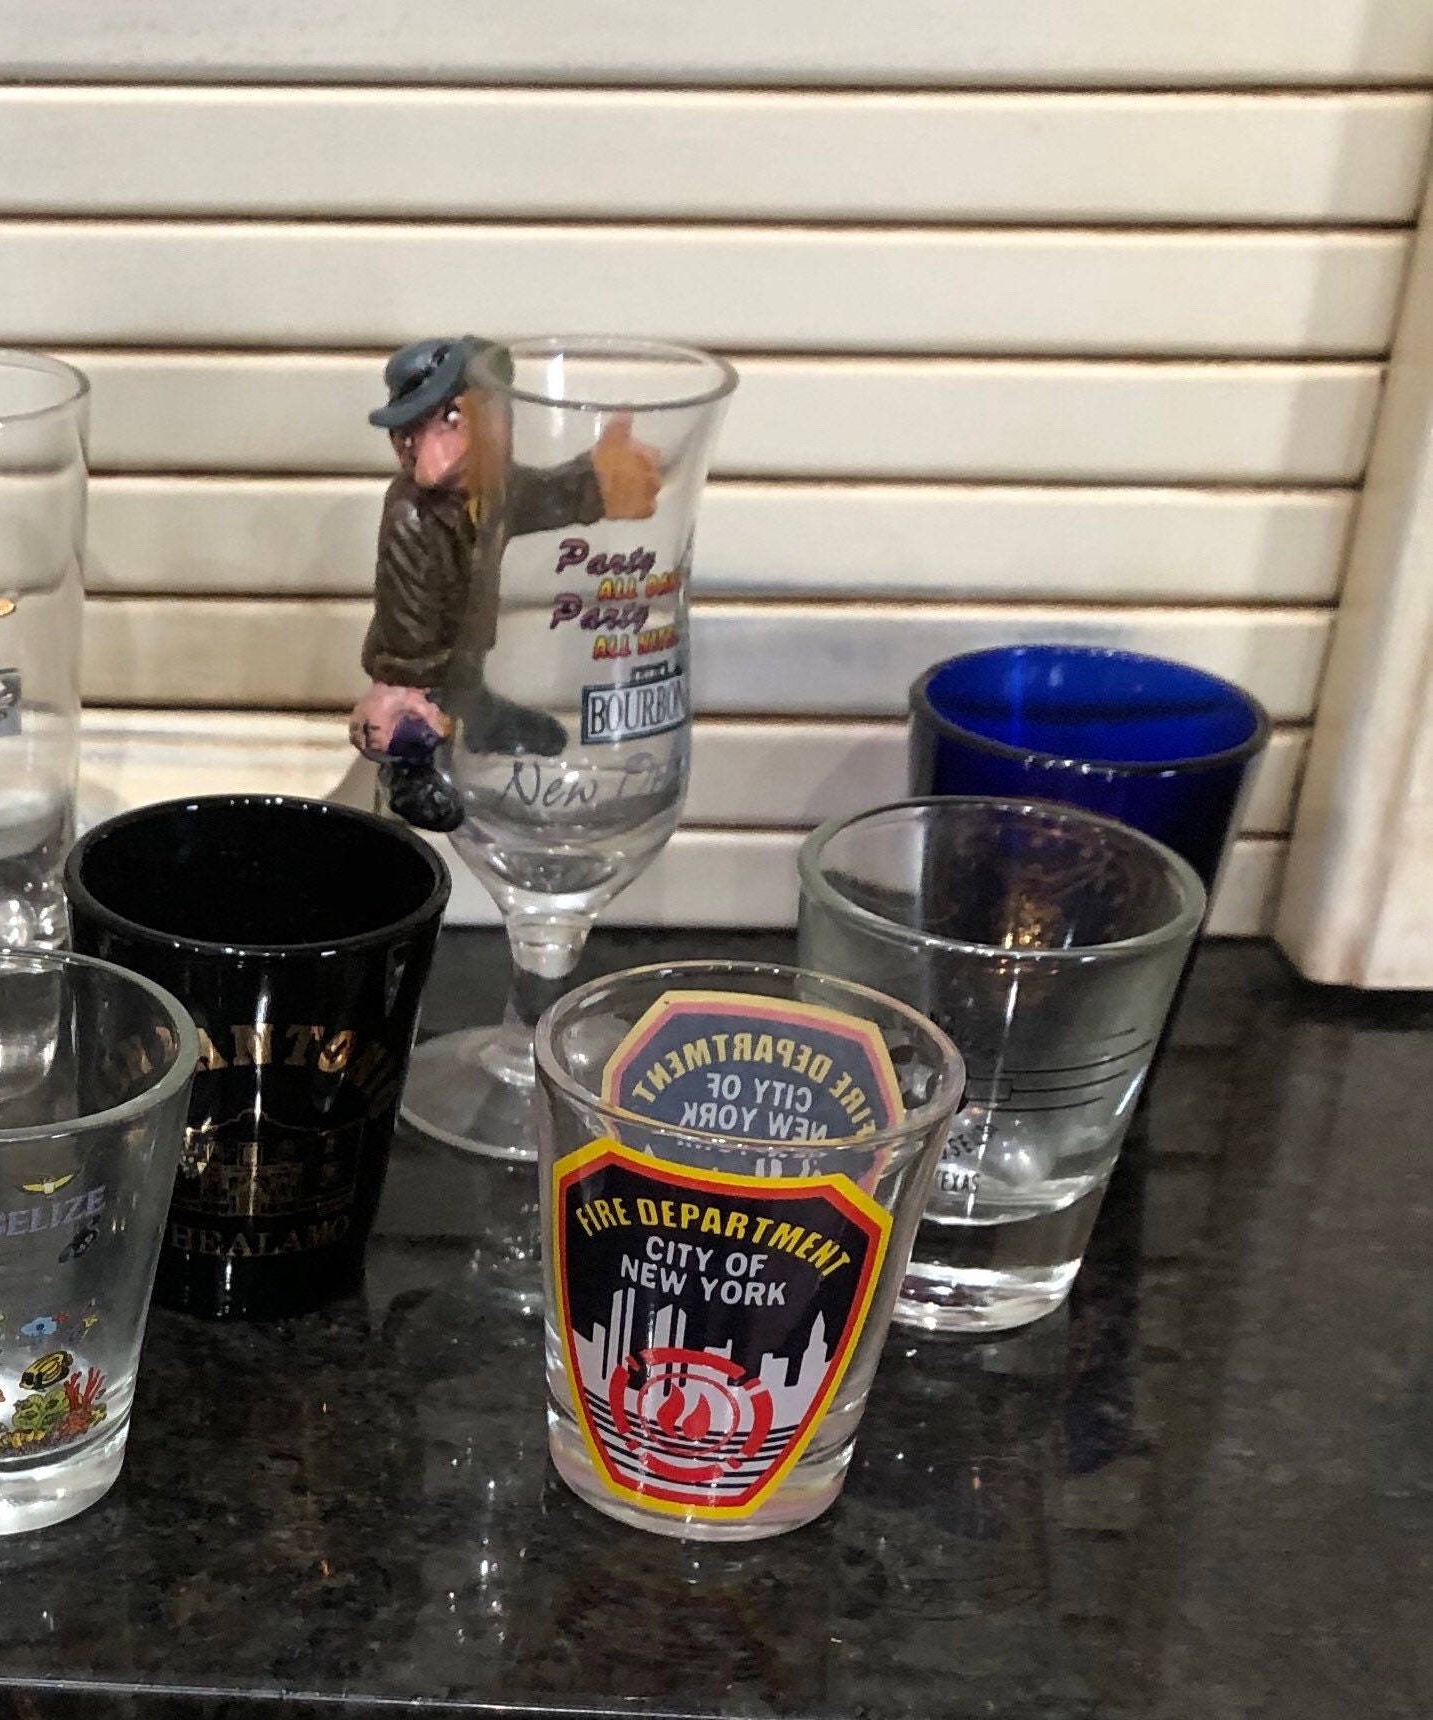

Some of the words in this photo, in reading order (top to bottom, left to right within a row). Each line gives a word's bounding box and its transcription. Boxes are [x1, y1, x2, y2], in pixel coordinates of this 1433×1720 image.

[556, 538, 656, 581] Party
[597, 576, 638, 601] ALL
[549, 593, 650, 634] Party
[592, 634, 631, 661] ALL
[500, 761, 599, 808] New
[576, 1197, 631, 1237] FIRE
[636, 1199, 852, 1278] DEPARTMENT
[645, 1235, 714, 1272] CITY
[726, 1252, 769, 1279] OF
[620, 1255, 687, 1296] NEW
[700, 1276, 787, 1307] YORK
